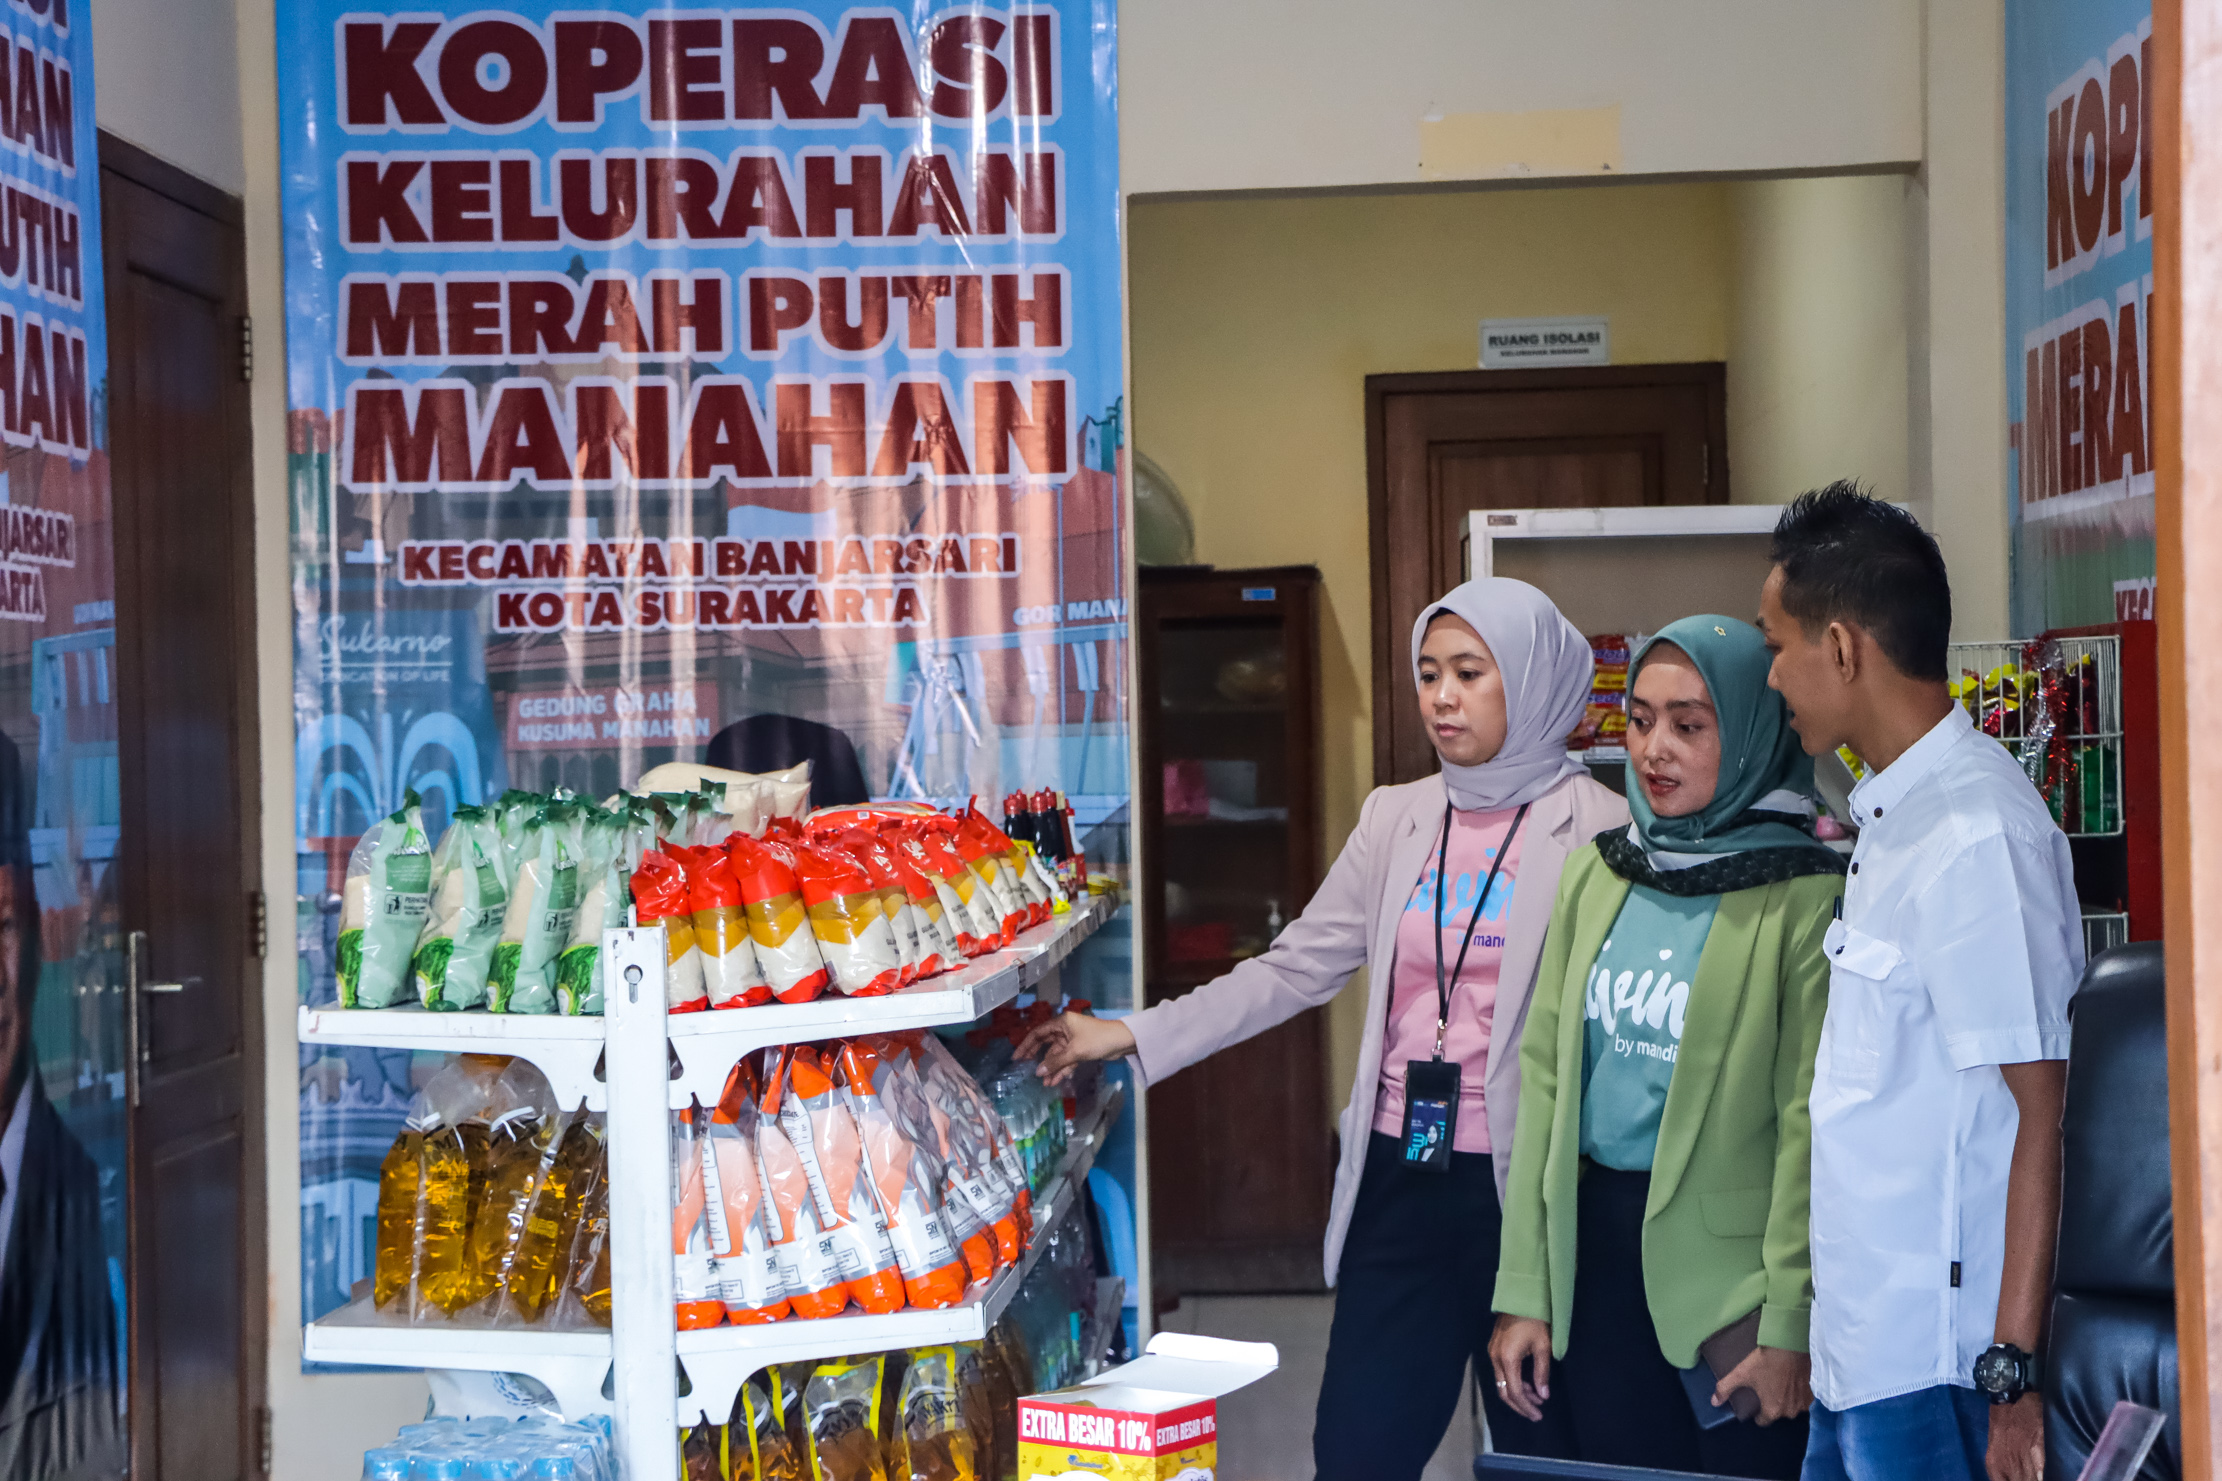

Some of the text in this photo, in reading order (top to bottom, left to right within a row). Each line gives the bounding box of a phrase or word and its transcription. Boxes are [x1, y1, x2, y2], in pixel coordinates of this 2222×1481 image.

[345, 16, 1053, 126] KOPERASI
[346, 152, 1056, 244] KELURAHAN
[346, 273, 1062, 357] MERAH PUTIH
[1488, 331, 1600, 347] RUANG ISOLASI
[351, 379, 1069, 484] MANAHAN
[404, 537, 1016, 583] KECAMATAN BANJARSARI
[499, 586, 926, 629] KOTA SURAKARTA
[1013, 604, 1063, 626] GOR
[321, 615, 452, 660] Sukarno
[518, 690, 697, 718] GEDUNG GRAHA
[518, 718, 711, 742] KUSUMA MANAHAN
[1615, 1034, 1635, 1058] by
[1022, 1407, 1151, 1451] EXTRA BESAR 10%
[1156, 1414, 1216, 1447] EXTRA BESAR 10%
